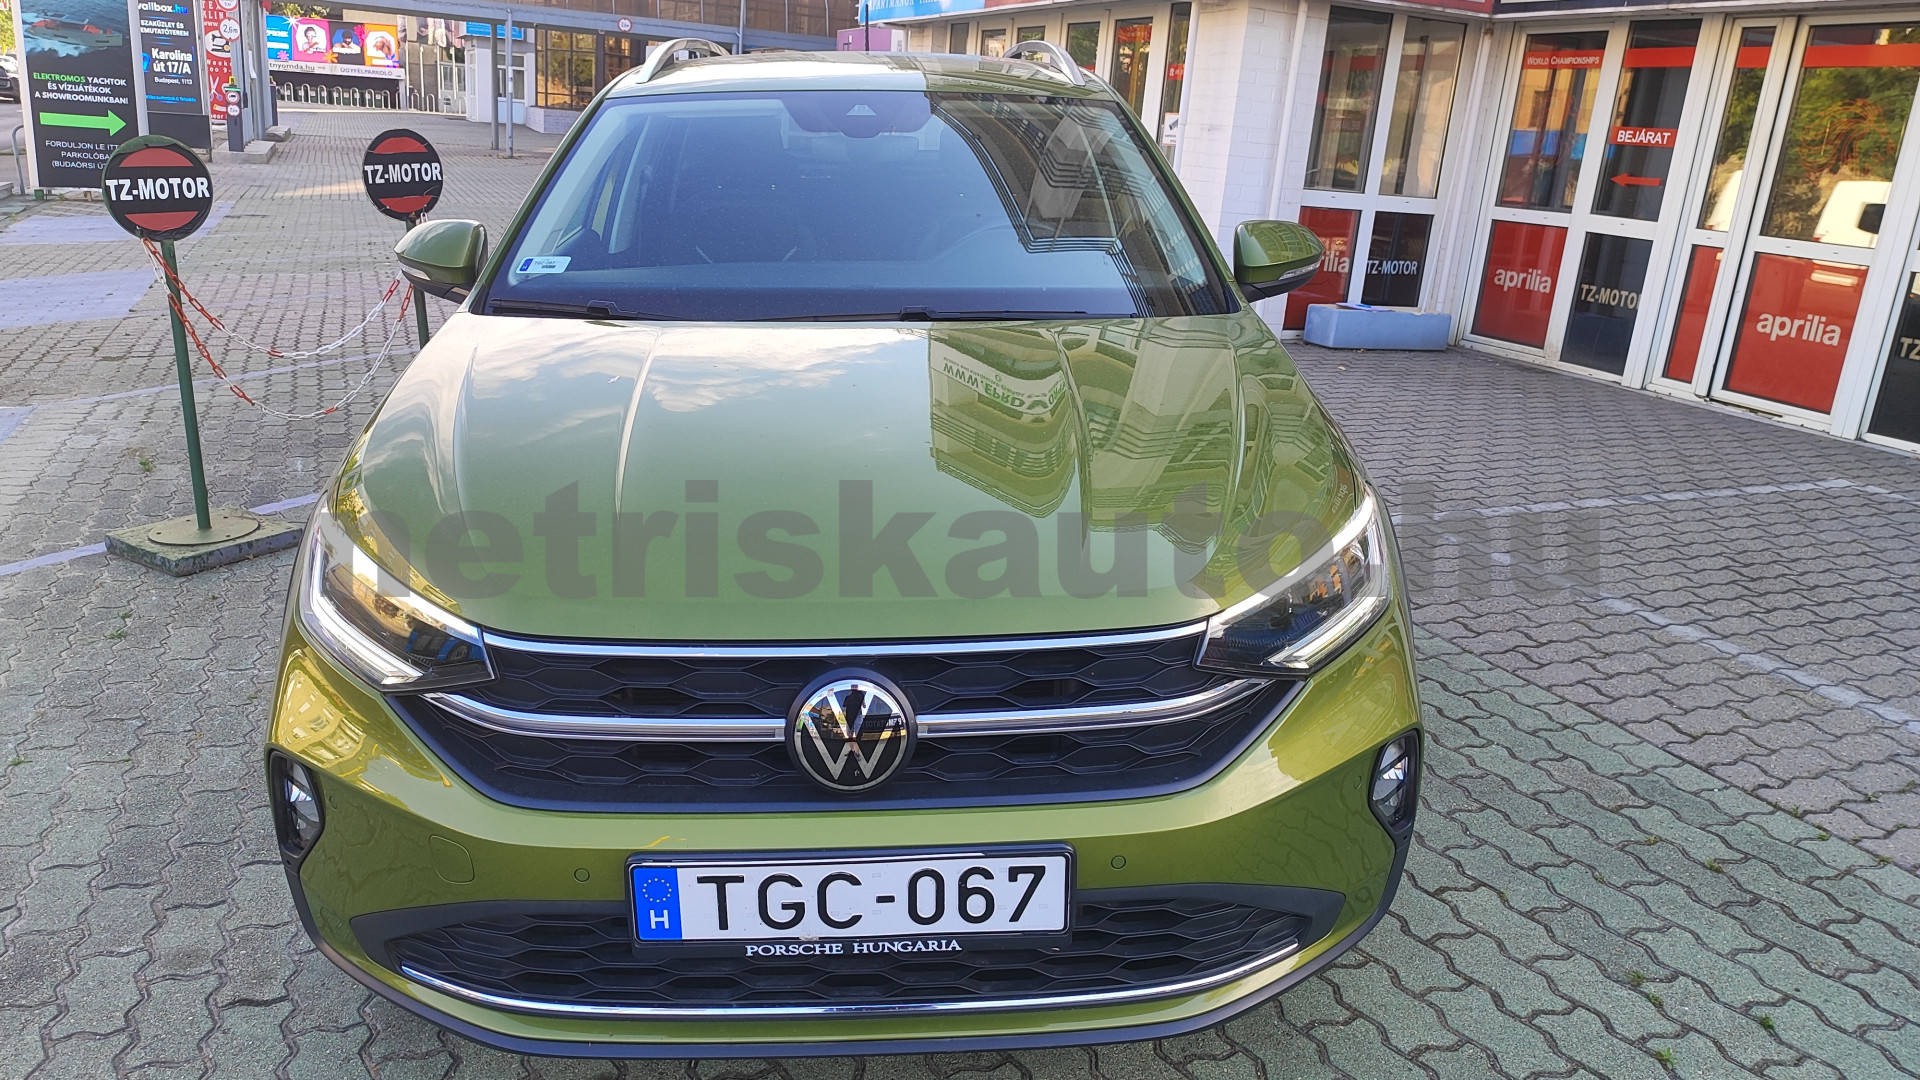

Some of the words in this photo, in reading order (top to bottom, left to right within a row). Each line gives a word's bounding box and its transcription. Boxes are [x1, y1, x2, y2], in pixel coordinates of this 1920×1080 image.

[151, 48, 193, 61] Karolina
[153, 60, 166, 72] út
[166, 61, 192, 75] 17/A
[33, 72, 86, 83] ELEKTROMOS
[87, 77, 127, 87] YACHTOK
[47, 81, 57, 90] ÉS
[42, 91, 129, 105] SHOWROOMUNKBAN!
[45, 140, 94, 150] FORDULJON
[1617, 129, 1671, 145] BEJÁRAT
[364, 162, 442, 184] TZ-MOTOR
[105, 177, 211, 201] TZ-MOTOR
[1367, 260, 1418, 275] TZ-MOTOR
[1494, 268, 1552, 294] aprilia
[1756, 313, 1842, 347] aprilia
[697, 865, 1046, 931] TGC-067
[650, 909, 669, 929] H
[745, 943, 844, 956] PORSCHE
[852, 939, 962, 954] HUNGARIA
